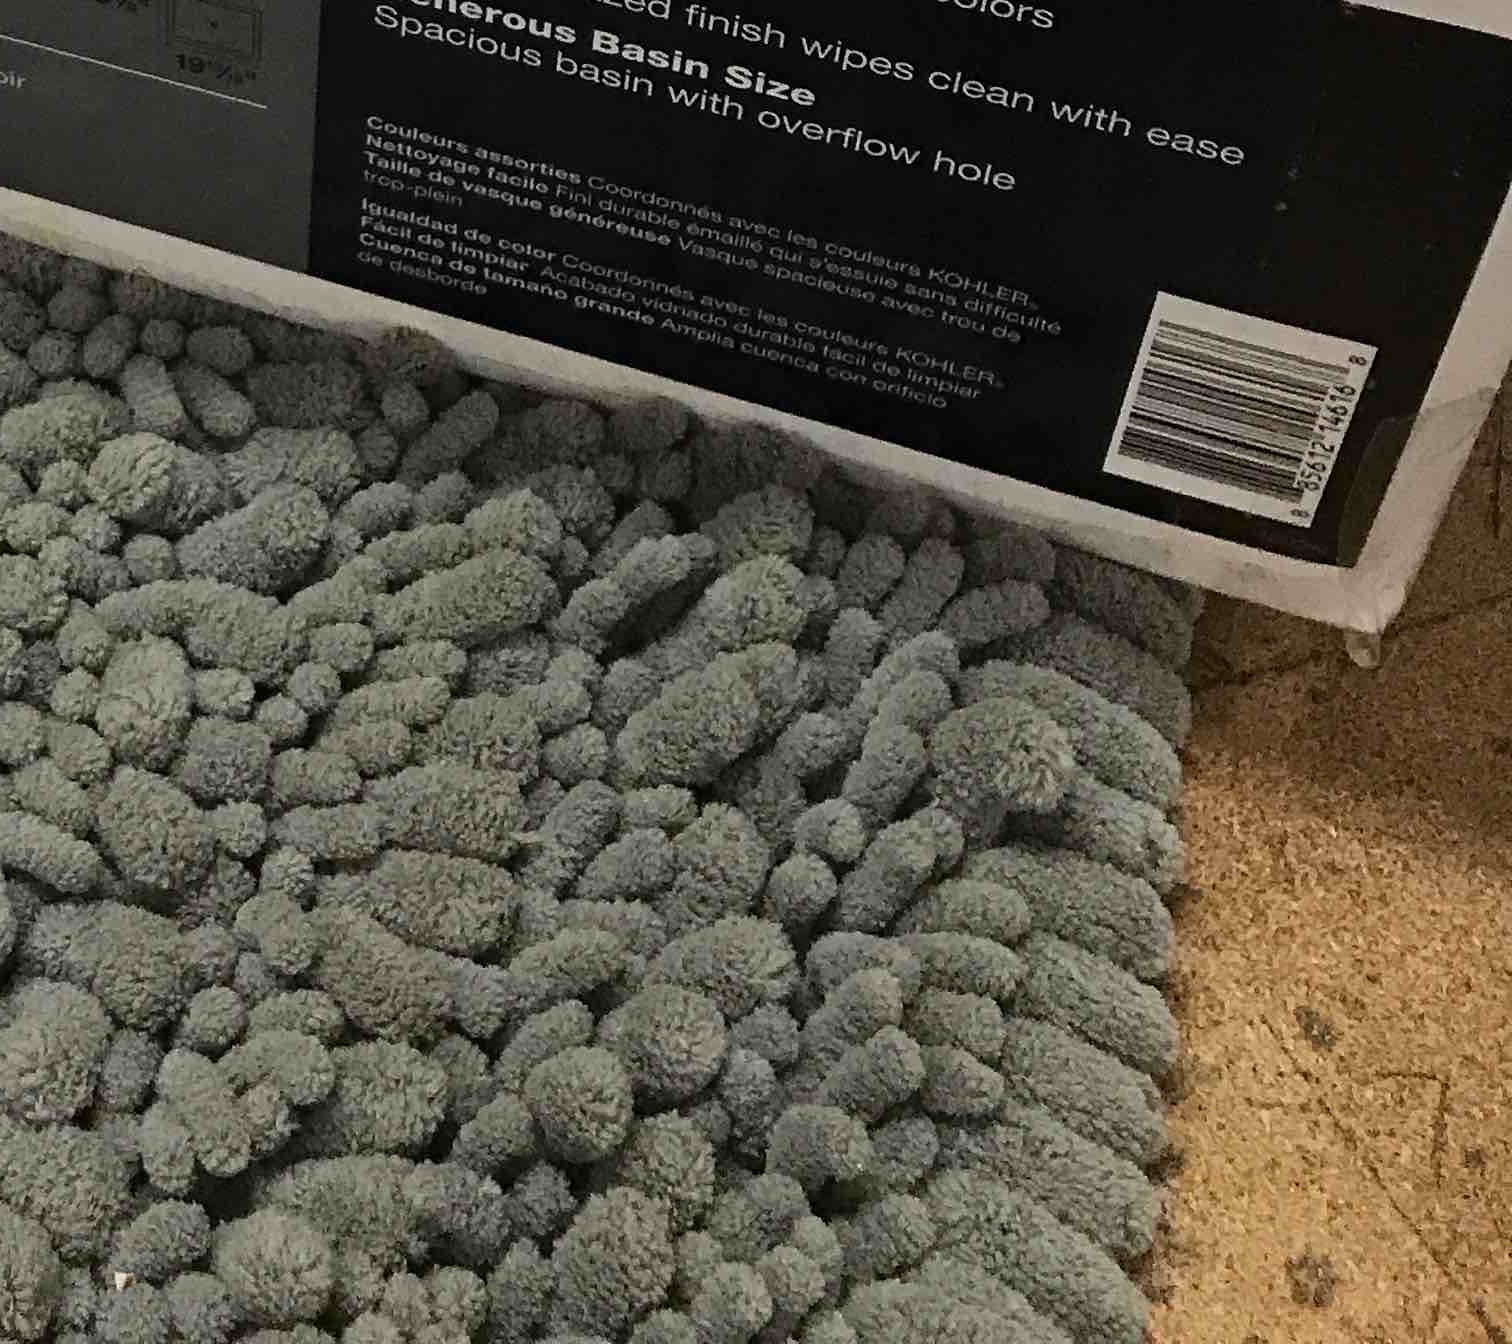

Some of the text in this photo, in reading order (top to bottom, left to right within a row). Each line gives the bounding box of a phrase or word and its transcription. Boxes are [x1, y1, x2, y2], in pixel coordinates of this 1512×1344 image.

[374, 4, 1017, 190] Spacious basin with overflow hole
[592, 29, 710, 79] Basin
[724, 64, 816, 107] Size
[685, 4, 786, 49] finish
[800, 36, 914, 81] wipes
[928, 70, 1035, 113] clean
[1050, 100, 1133, 138] with
[1146, 127, 1245, 166] ease
[367, 116, 469, 154] Couleurs
[474, 147, 581, 184] assorties
[367, 134, 480, 176] Nettoyage
[488, 166, 549, 194] facile
[598, 198, 680, 230] durable
[362, 198, 458, 235] Igualdad
[464, 228, 491, 244] de
[499, 239, 557, 261] color
[363, 150, 422, 177] Taille
[428, 170, 456, 186] de
[462, 181, 542, 210] vasque
[992, 326, 1021, 344] de
[417, 233, 445, 249] de
[451, 241, 529, 271] limpiar
[360, 233, 443, 265] Cuenca
[449, 259, 477, 275] de
[574, 295, 655, 325] grande
